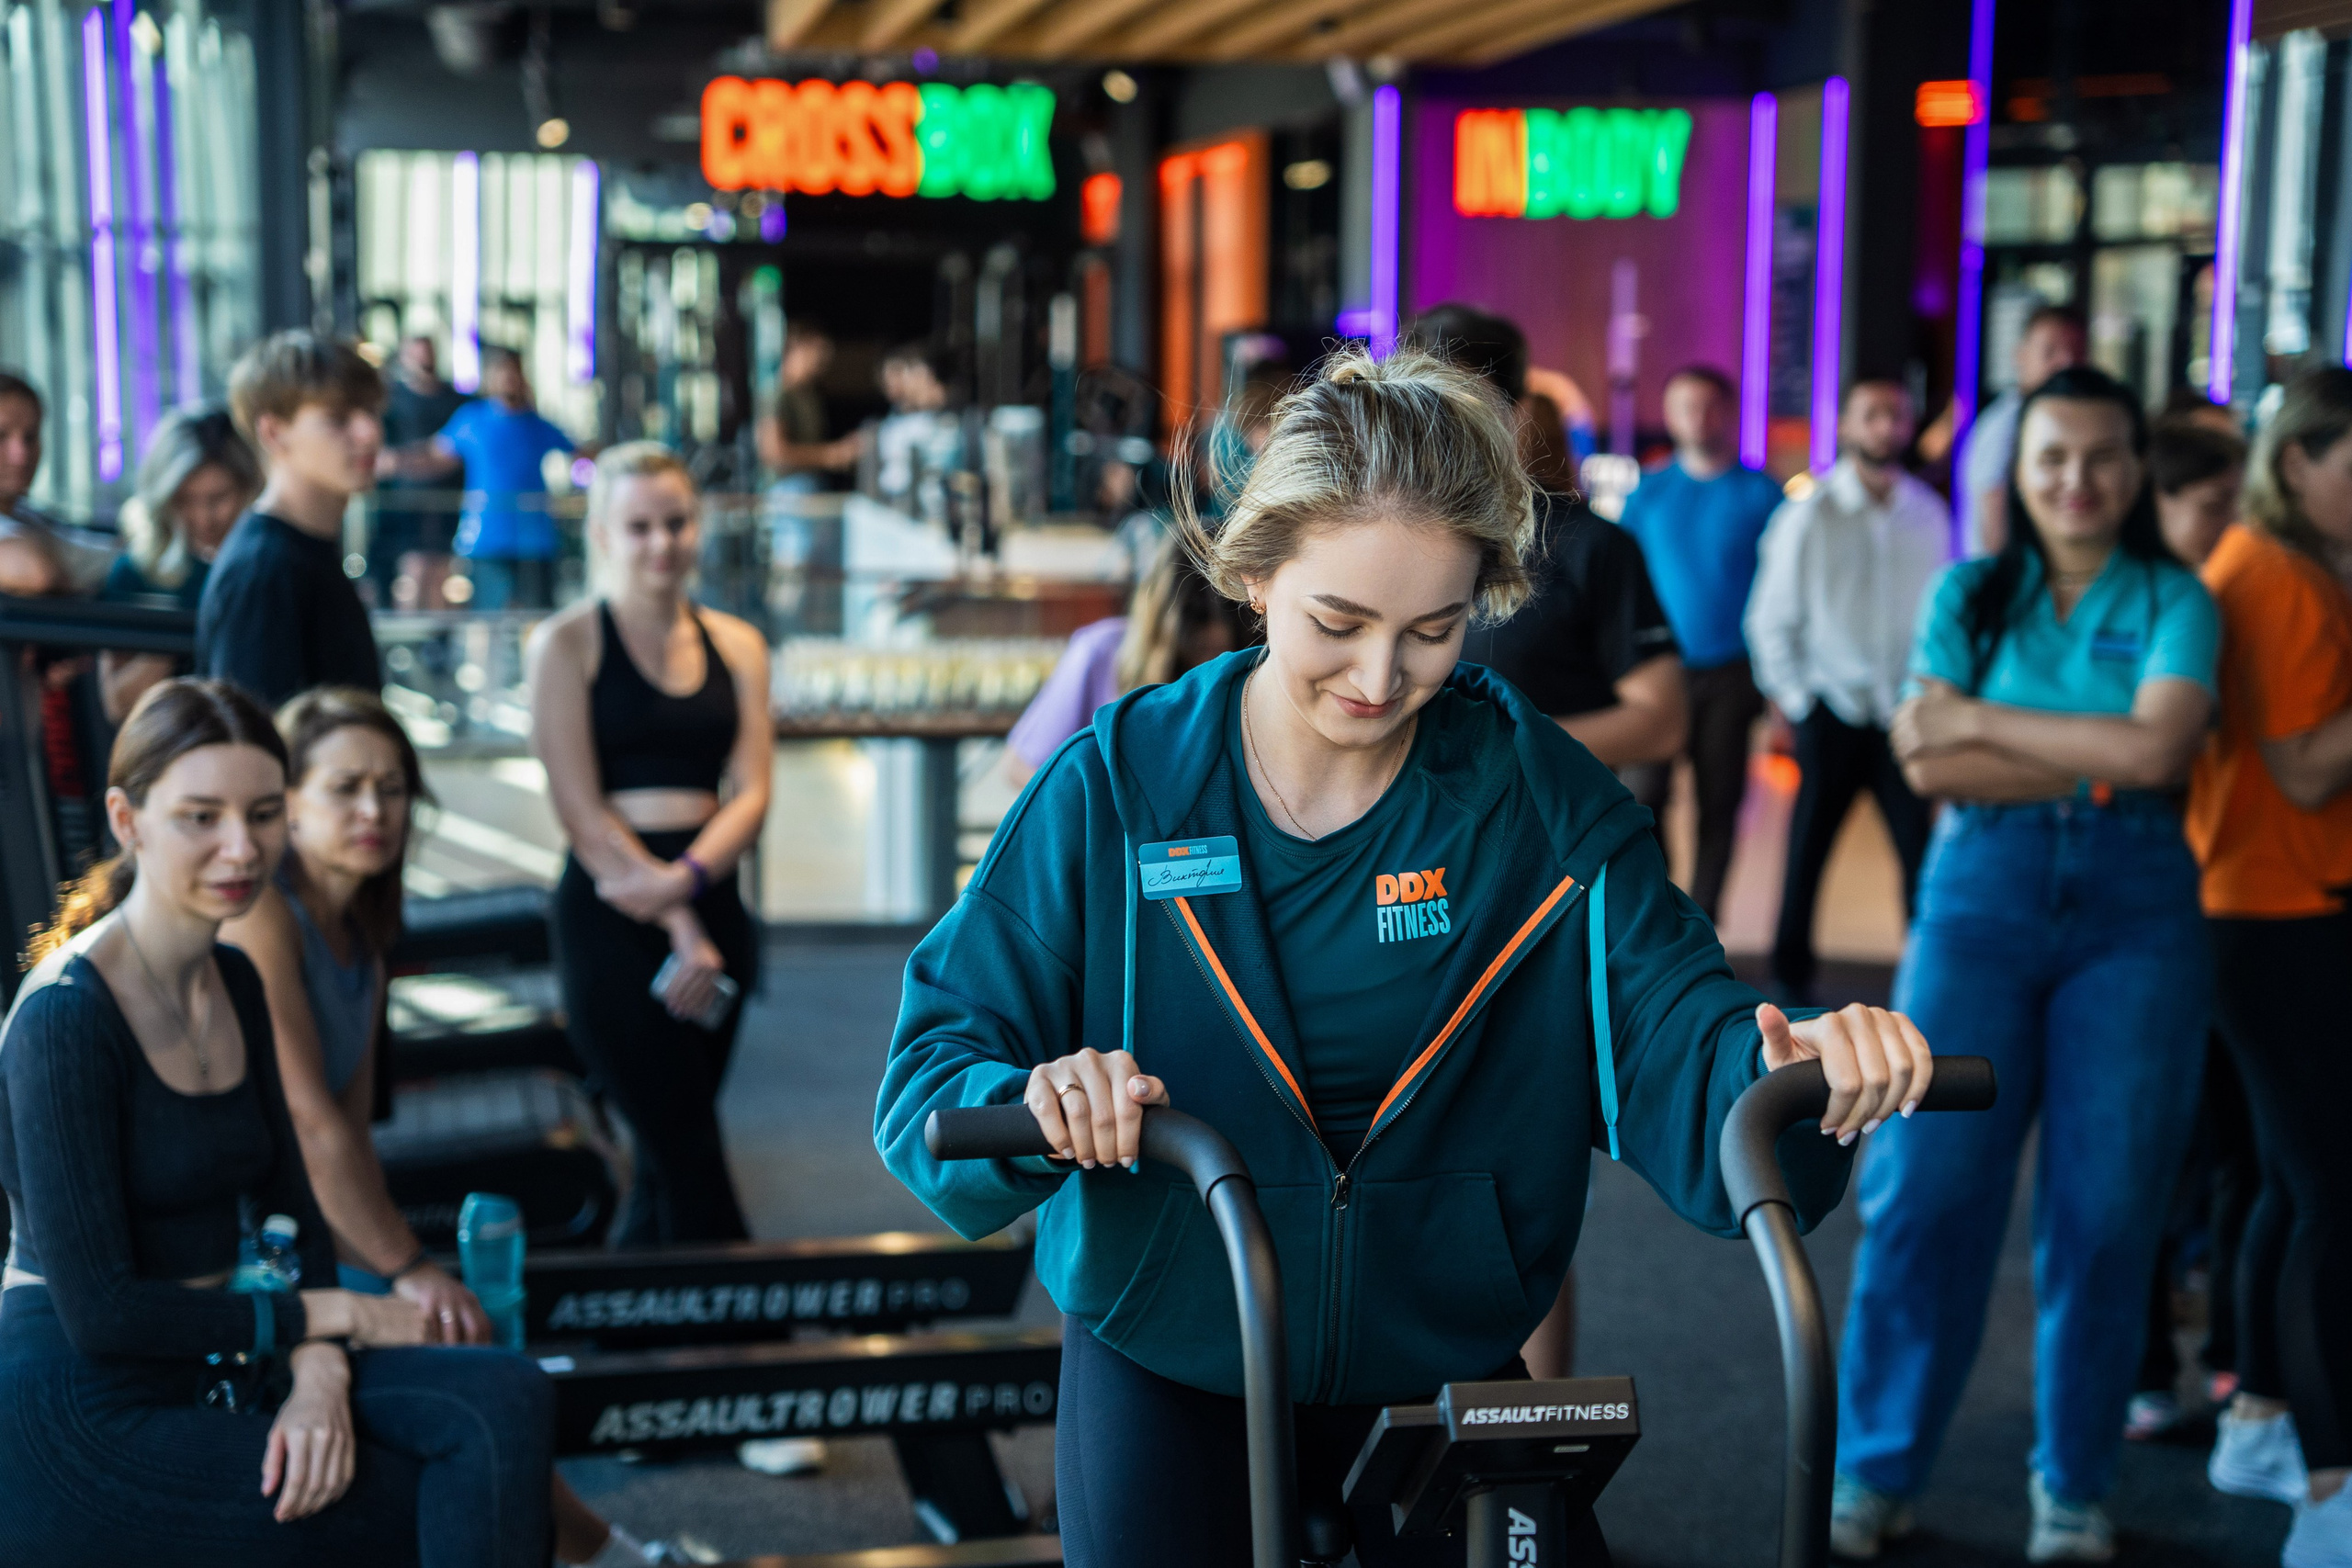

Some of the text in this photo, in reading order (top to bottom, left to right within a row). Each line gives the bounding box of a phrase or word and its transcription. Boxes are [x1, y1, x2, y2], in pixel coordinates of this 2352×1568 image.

[1375, 867, 1448, 906] DDX
[1376, 897, 1451, 943] FITNESS
[548, 1279, 881, 1329] ASSAULTROWER
[591, 1381, 1055, 1443] ASSAULTROWER PRO
[1508, 1507, 1537, 1568] AS
